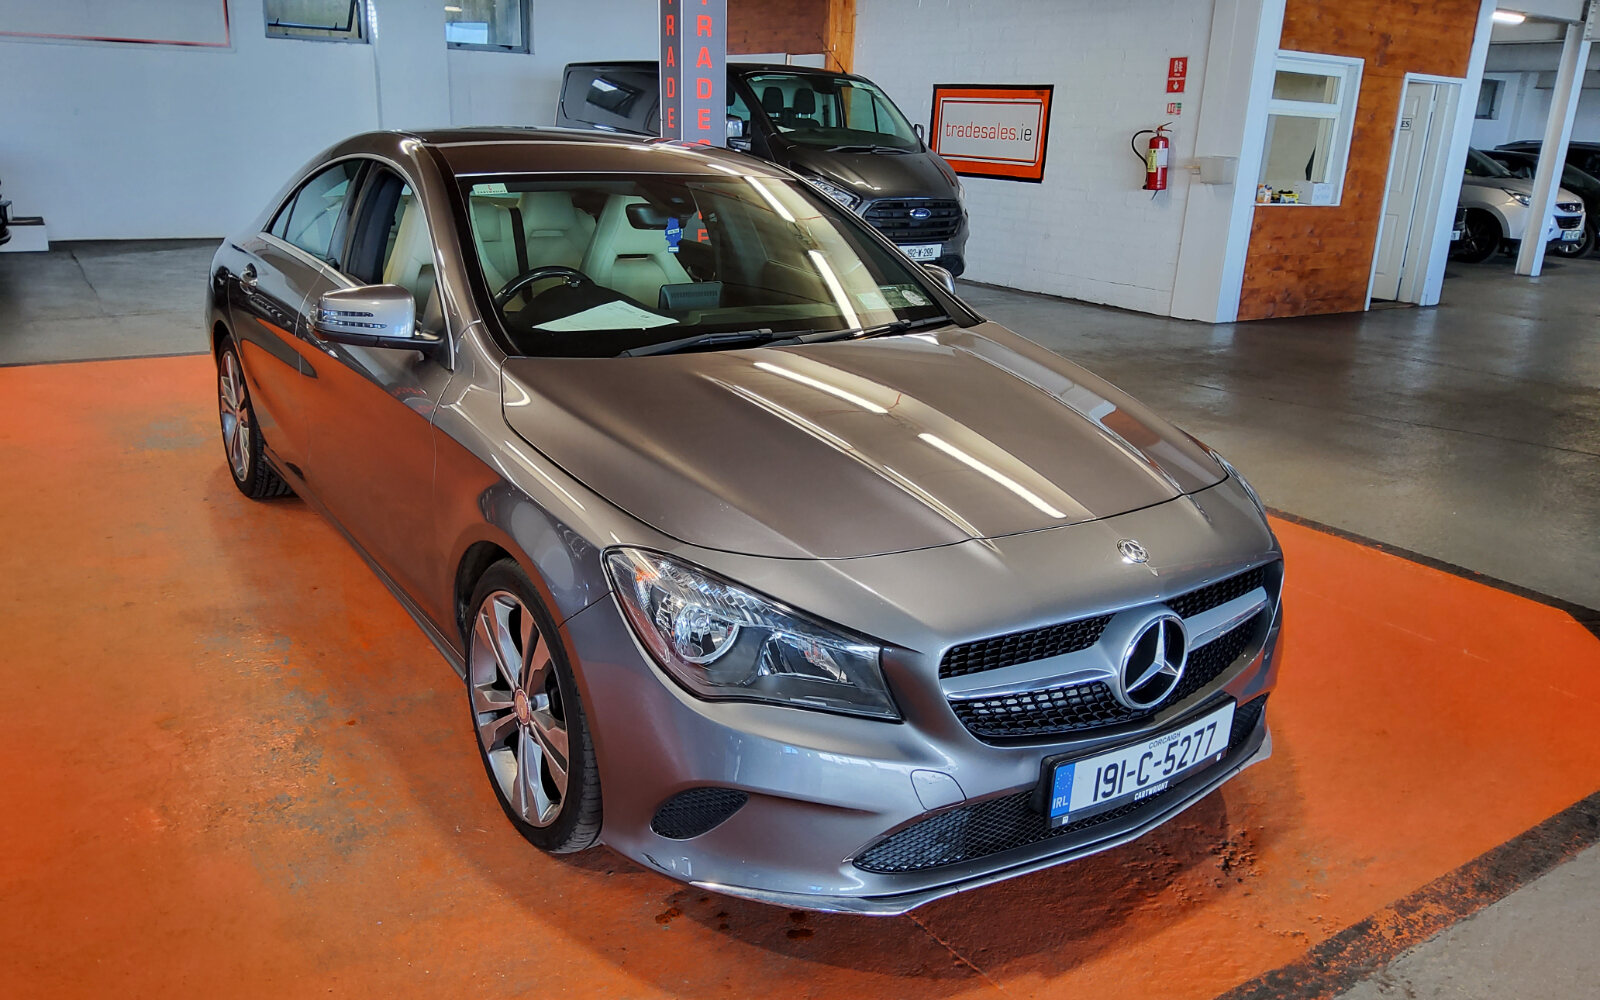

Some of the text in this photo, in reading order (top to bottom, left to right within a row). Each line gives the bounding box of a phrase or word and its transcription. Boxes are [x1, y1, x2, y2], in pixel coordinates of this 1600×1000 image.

[666, 0, 676, 129] RADE
[946, 121, 1032, 142] tradesales.ie
[1148, 731, 1181, 750] CORCAIGH
[1092, 721, 1218, 803] 191-C-5277
[1052, 795, 1069, 810] IRL
